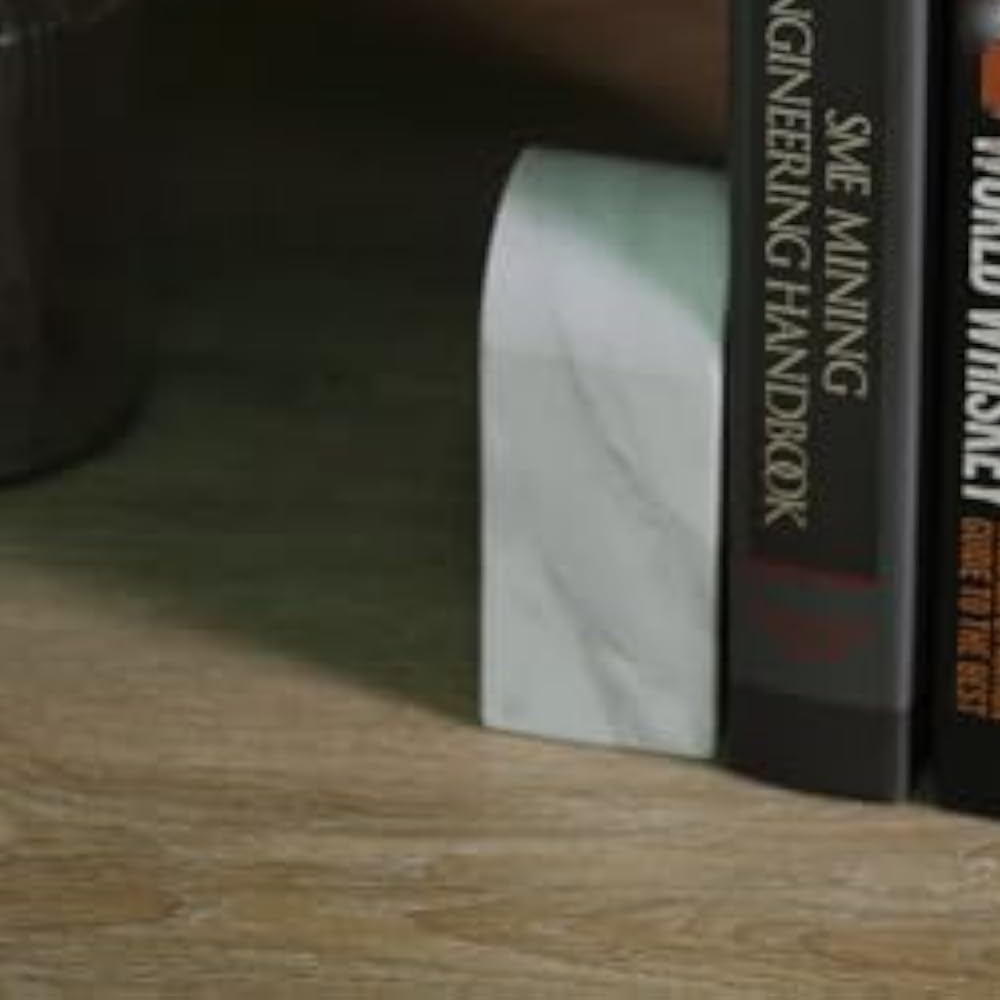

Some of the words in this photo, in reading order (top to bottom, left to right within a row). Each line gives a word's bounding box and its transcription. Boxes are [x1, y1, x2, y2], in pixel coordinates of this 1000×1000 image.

[824, 108, 872, 198] SME
[821, 206, 870, 400] MINING
[764, 278, 811, 530] HANDBOOK
[956, 618, 993, 659] THE
